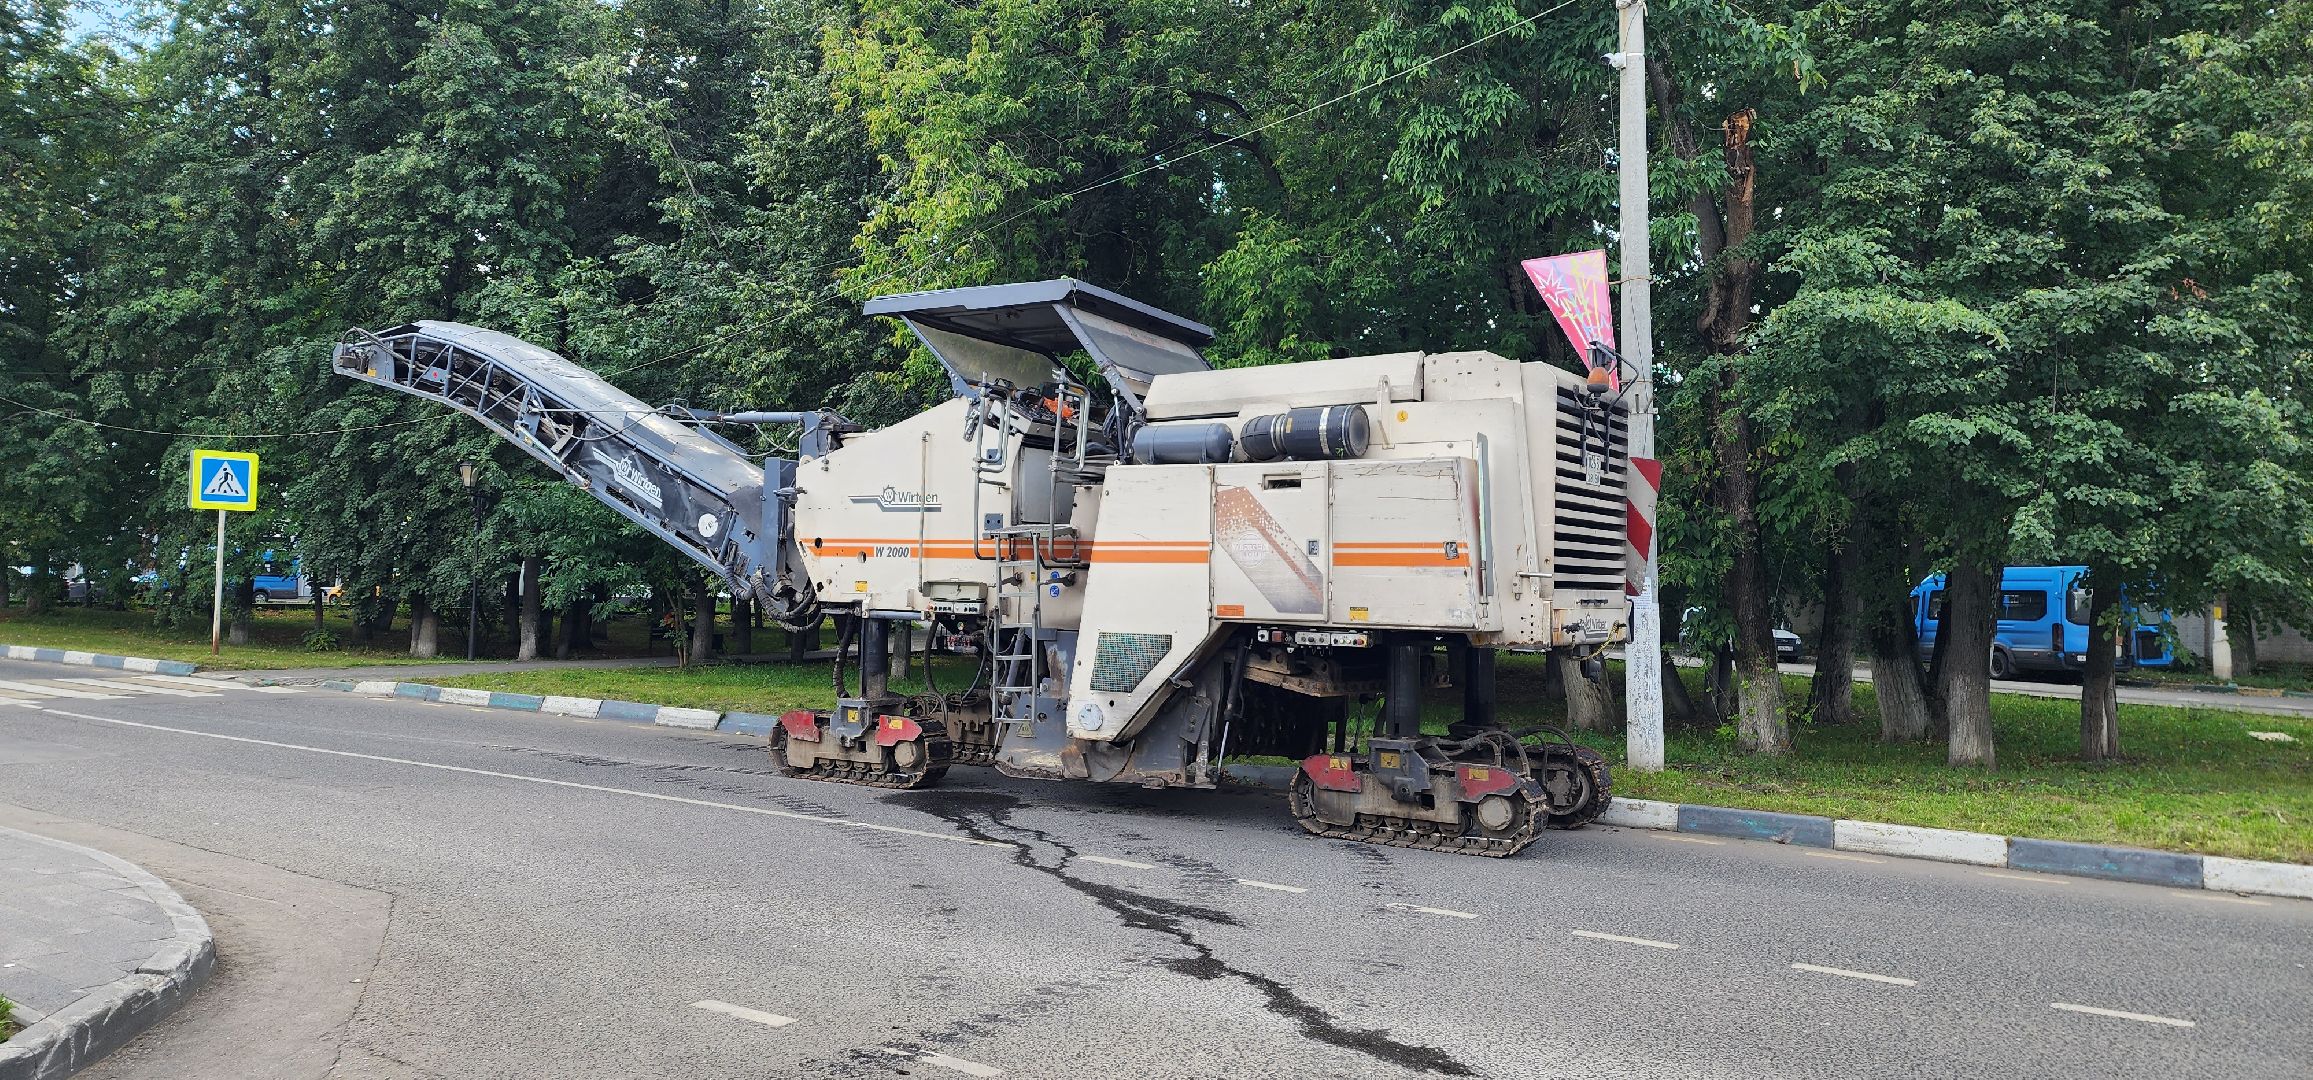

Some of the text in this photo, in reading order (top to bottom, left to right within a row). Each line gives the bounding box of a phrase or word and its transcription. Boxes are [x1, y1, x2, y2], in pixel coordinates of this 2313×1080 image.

[631, 468, 661, 498] Wirtgen
[876, 546, 910, 557] W 2000
